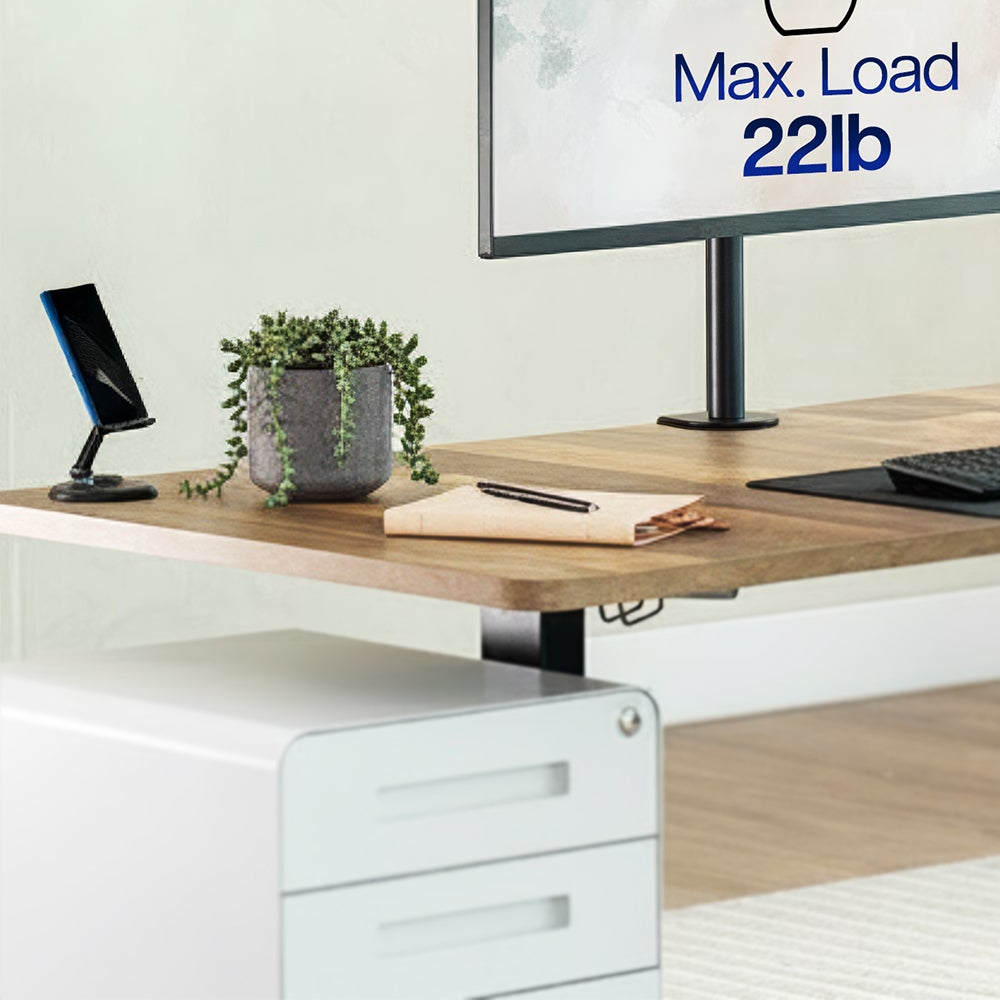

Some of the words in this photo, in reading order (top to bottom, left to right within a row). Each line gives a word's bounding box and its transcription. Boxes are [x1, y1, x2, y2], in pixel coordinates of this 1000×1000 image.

[674, 51, 806, 103] Max.
[821, 42, 959, 97] Load
[743, 113, 892, 177] 22lb
